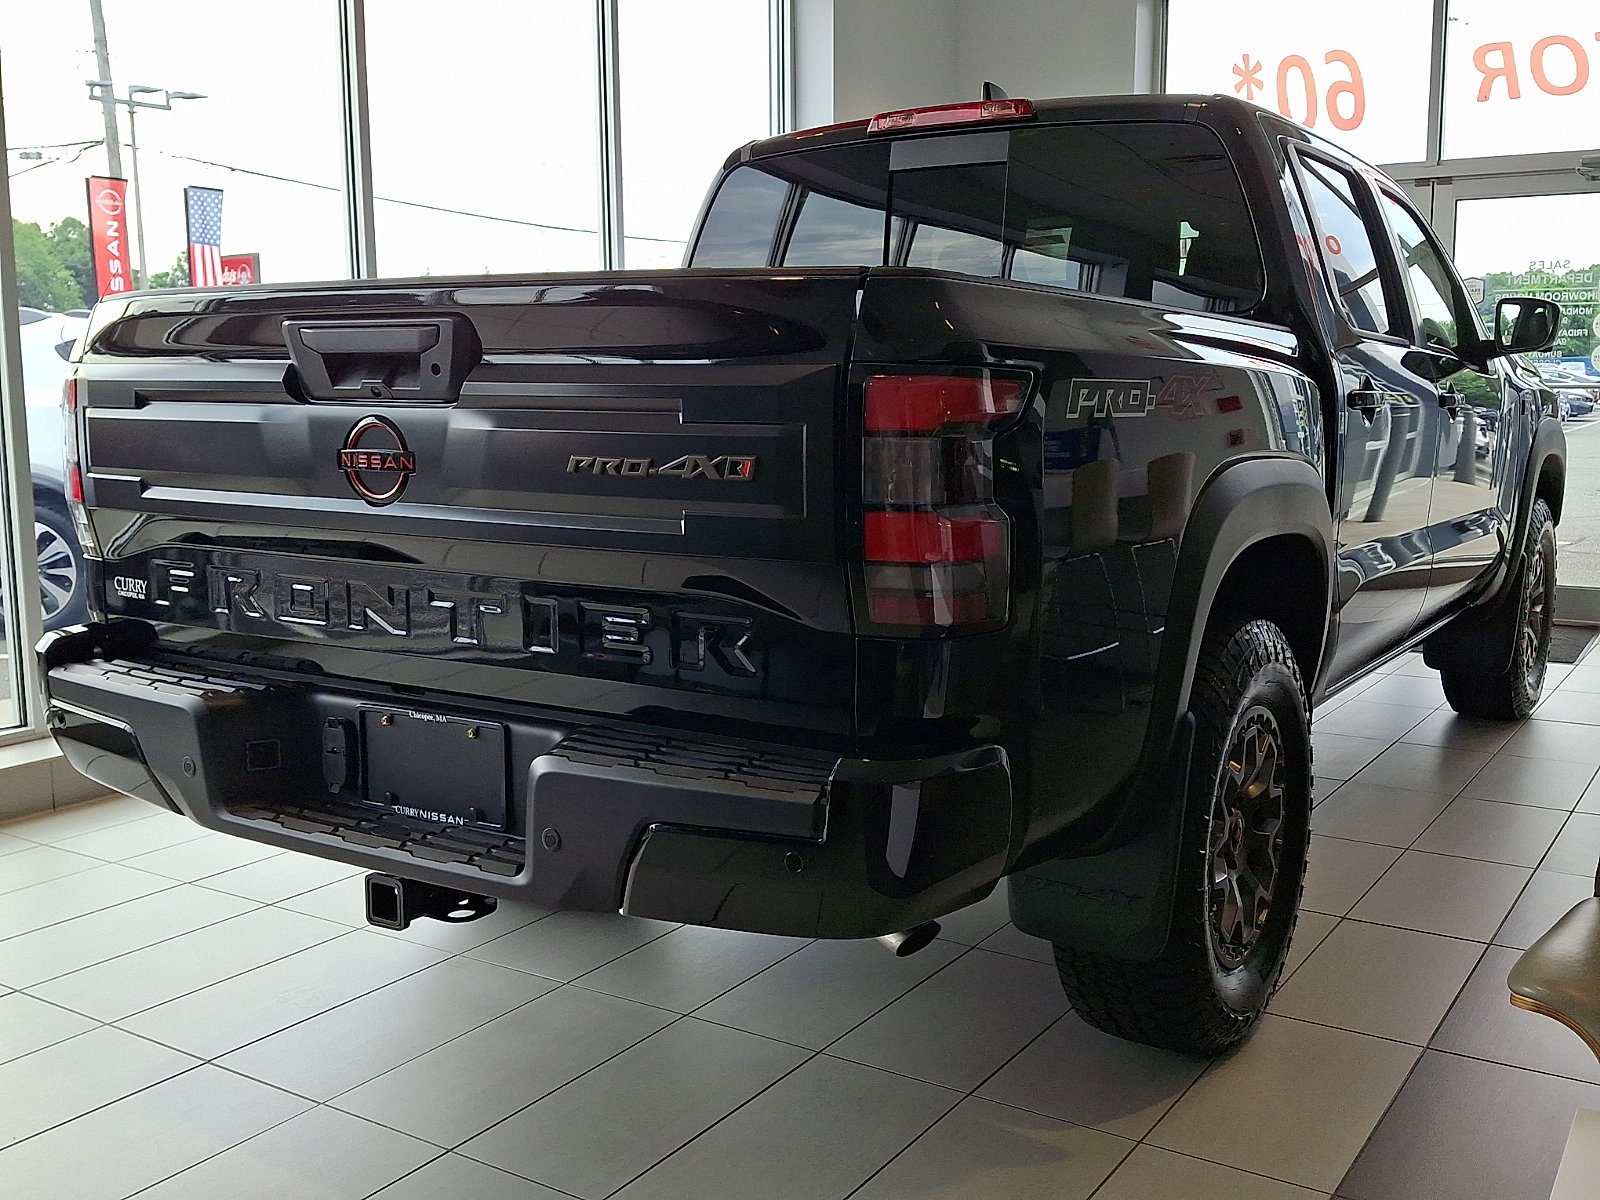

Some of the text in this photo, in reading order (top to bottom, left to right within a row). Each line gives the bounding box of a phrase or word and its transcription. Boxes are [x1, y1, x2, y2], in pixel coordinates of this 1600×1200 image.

[106, 220, 125, 292] SSAN
[341, 453, 414, 469] NISSAN
[114, 576, 148, 594] CURRY
[151, 557, 759, 679] FRONTIER
